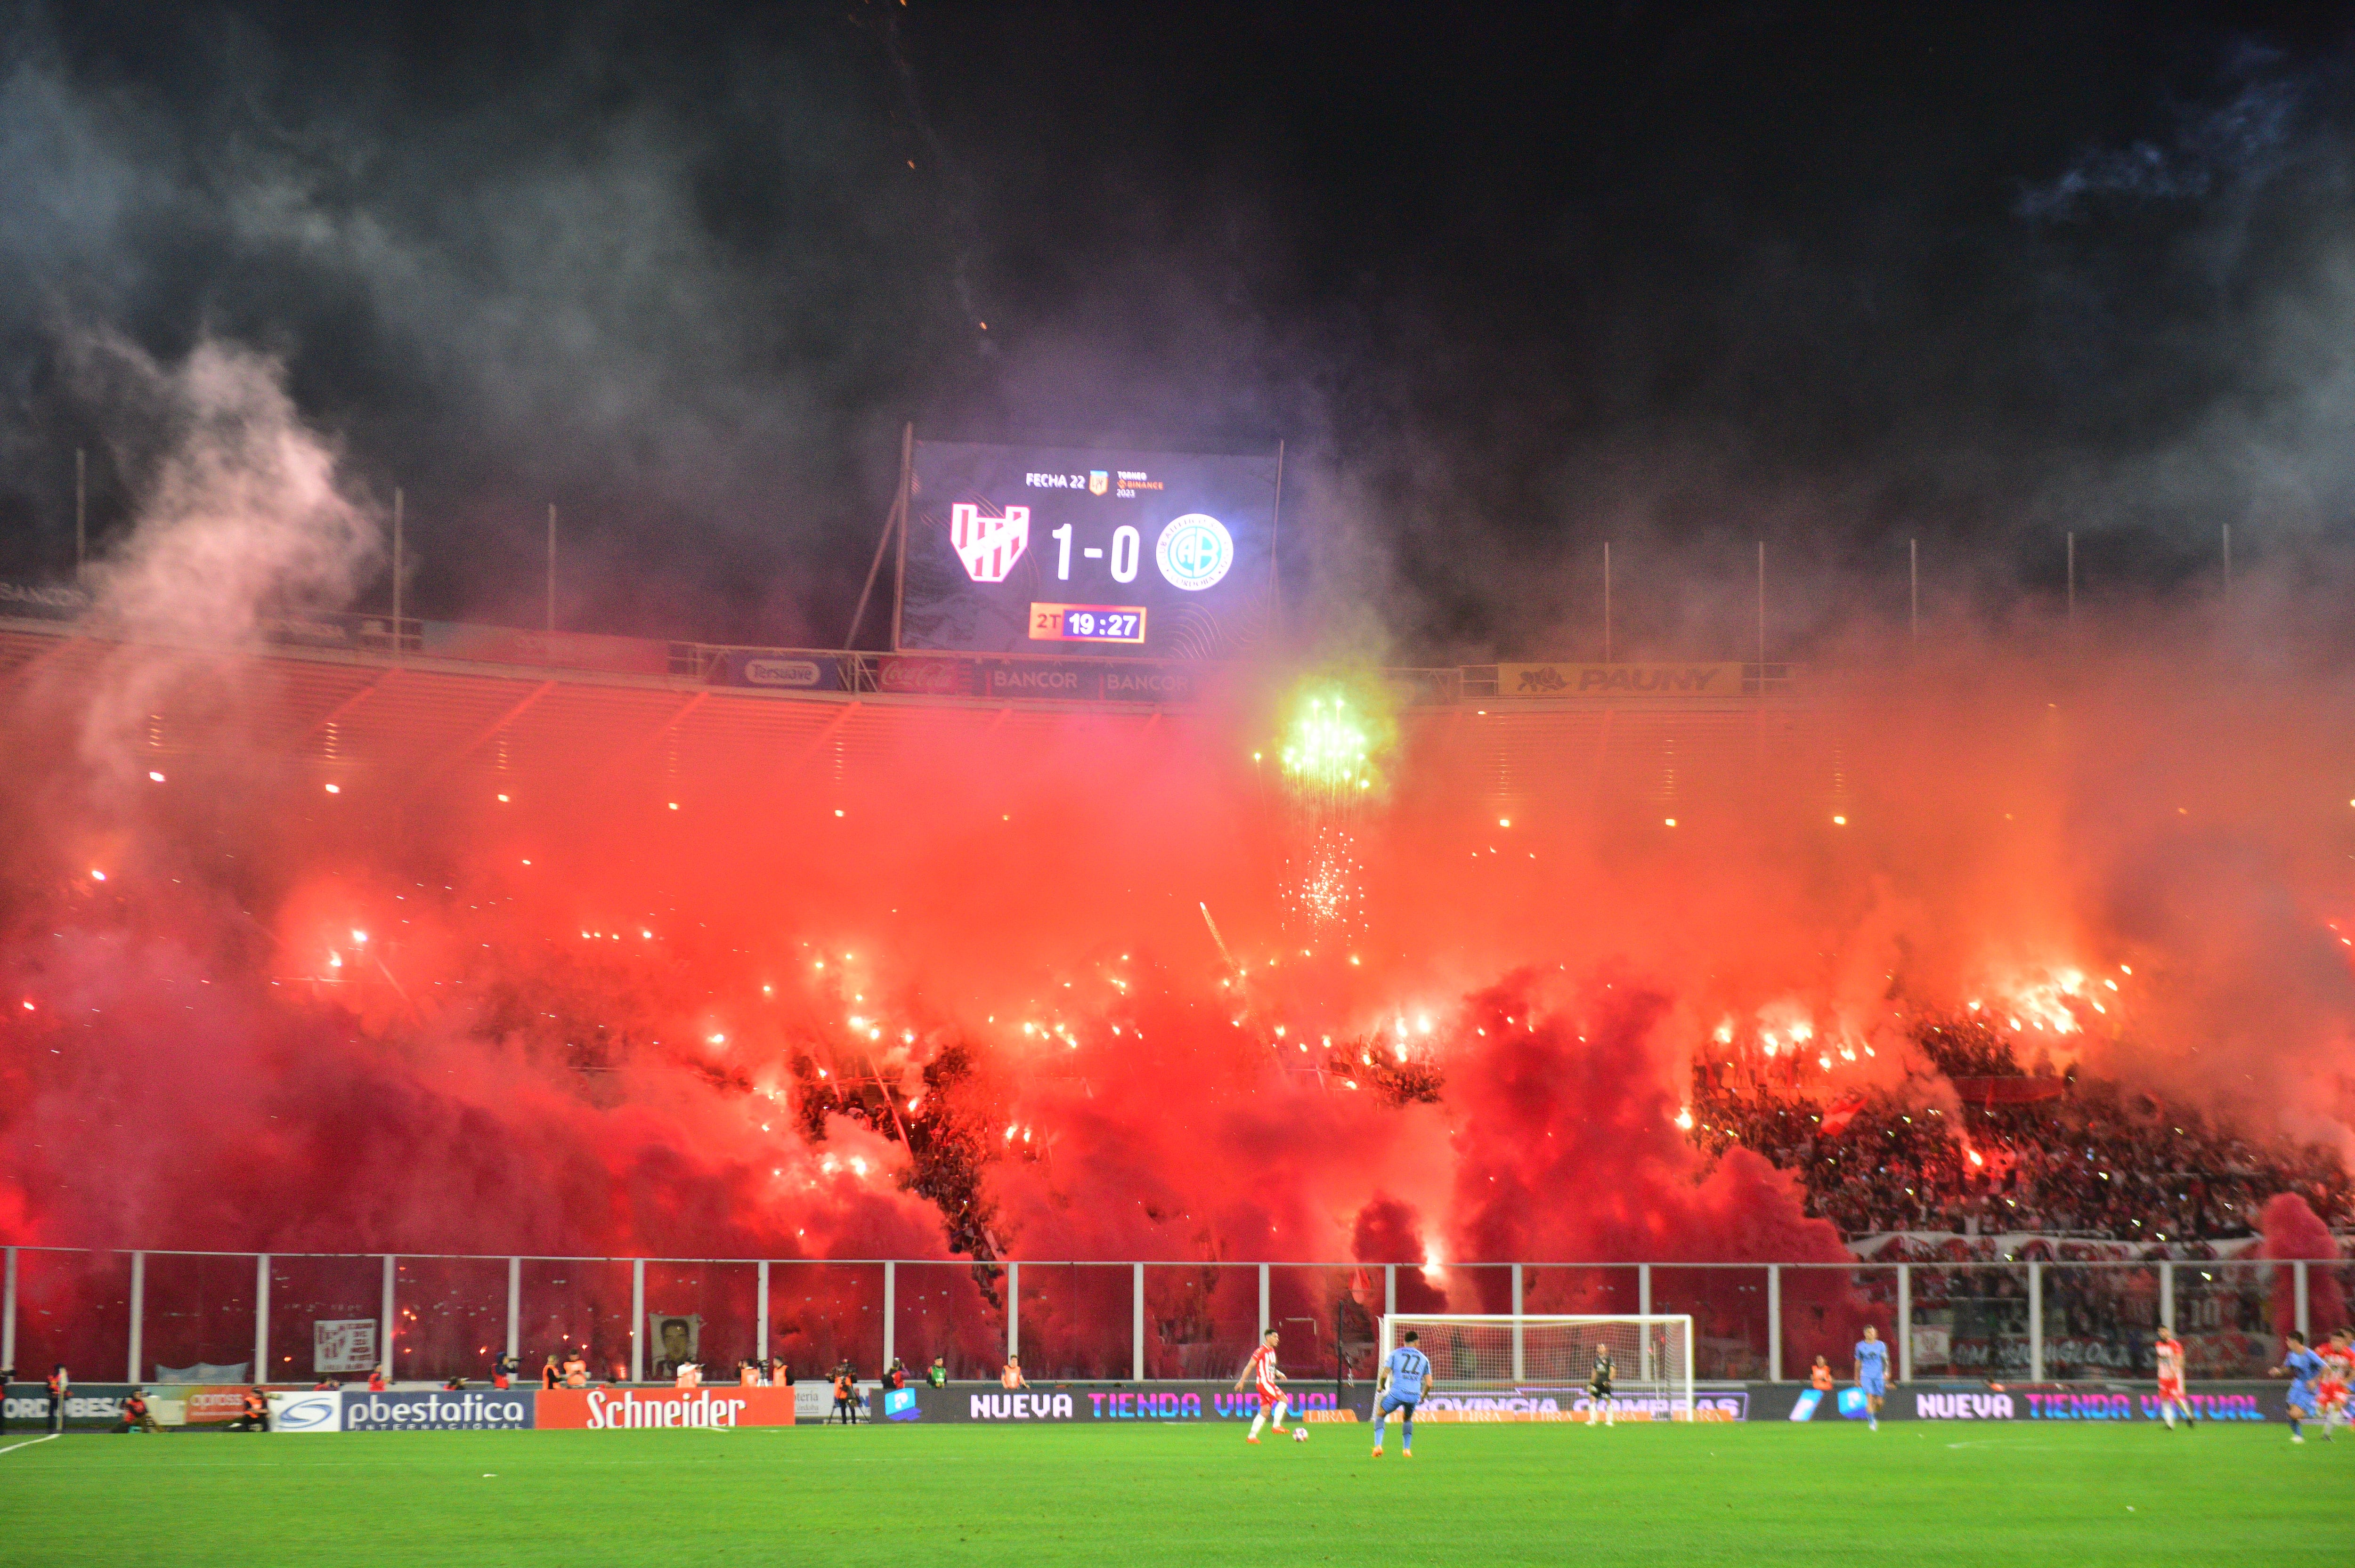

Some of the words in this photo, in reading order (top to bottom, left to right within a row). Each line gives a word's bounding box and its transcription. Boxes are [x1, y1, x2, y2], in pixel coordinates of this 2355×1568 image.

[1026, 473, 1068, 488] FECHA
[1070, 475, 1086, 489] 22
[1128, 481, 1164, 490] BINANCE
[1116, 489, 1136, 498] 2023
[1037, 614, 1061, 629] 2T
[1069, 613, 1137, 636] 19:27
[994, 671, 1078, 688] BANCOR
[1107, 673, 1189, 692] BANCOR
[1578, 668, 1722, 691] PAUNY
[1401, 1353, 1421, 1375] 22
[586, 1390, 747, 1429] Schneider
[970, 1393, 1073, 1418] NUEVA
[1088, 1392, 1202, 1418] TIENDA
[1916, 1393, 2014, 1419] NUEVA
[2025, 1394, 2132, 1419] TIENDA
[1308, 1410, 1346, 1423] LIBRA
[1459, 1411, 1501, 1422] LIBRA
